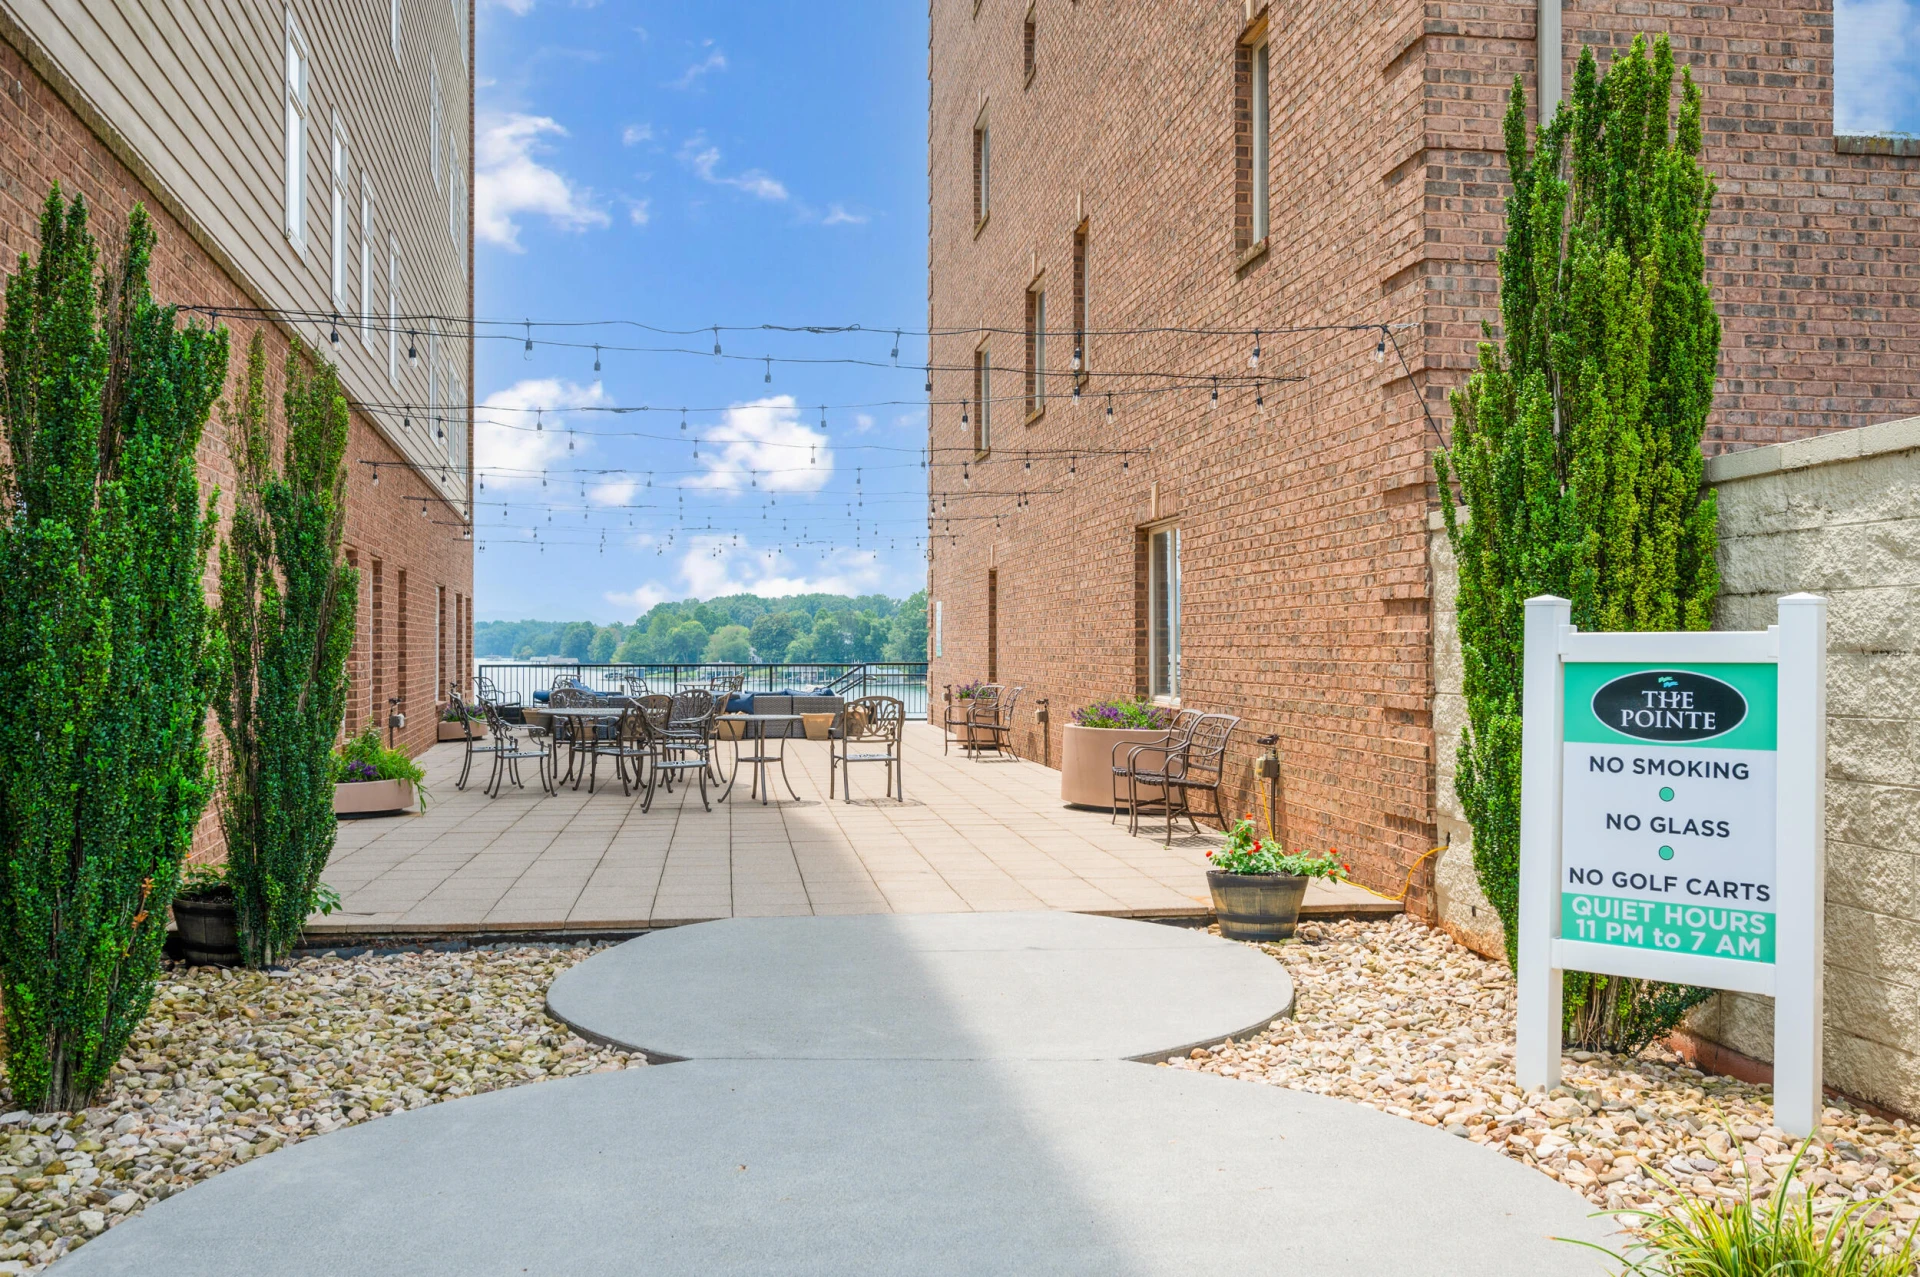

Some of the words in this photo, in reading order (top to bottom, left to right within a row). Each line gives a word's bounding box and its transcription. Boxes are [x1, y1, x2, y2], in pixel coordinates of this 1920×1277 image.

[1641, 690, 1694, 709] THE
[1620, 709, 1716, 730] POINTE
[1589, 755, 1624, 773] NO
[1632, 757, 1750, 780] SMOKING
[1606, 813, 1641, 831] NO
[1650, 816, 1730, 838] GLASS
[1569, 867, 1603, 885] NO
[1612, 871, 1678, 892] GOLF
[1686, 878, 1770, 902] CARTS
[1571, 896, 1655, 922] QUIET
[1664, 905, 1767, 935] HOURS
[1575, 918, 1596, 939] 11
[1605, 922, 1644, 945] PM
[1653, 927, 1681, 949] to
[1690, 931, 1706, 951] 7
[1715, 934, 1760, 958] AM
